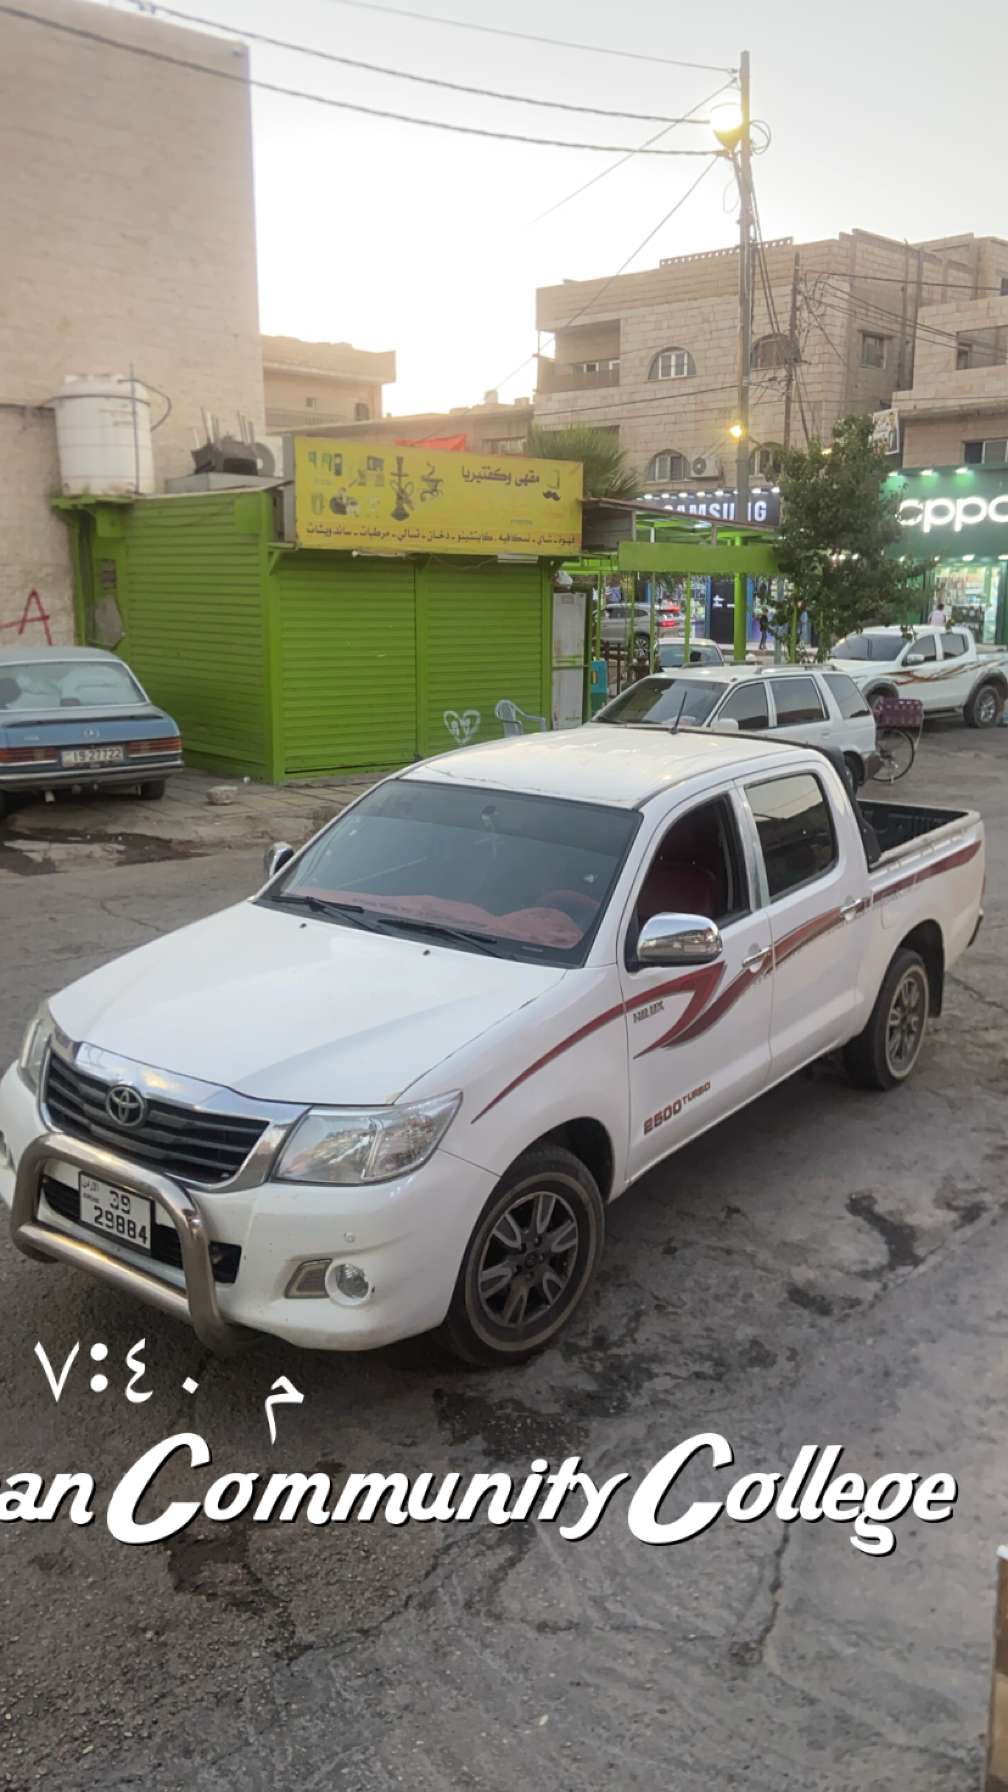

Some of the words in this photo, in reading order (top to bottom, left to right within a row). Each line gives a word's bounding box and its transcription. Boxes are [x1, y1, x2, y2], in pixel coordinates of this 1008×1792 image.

[663, 501, 767, 521] MSUG
[643, 1099, 682, 1136] 2500
[682, 1080, 711, 1104] TURBO
[110, 1190, 131, 1215] 39
[93, 1204, 148, 1245] 29884
